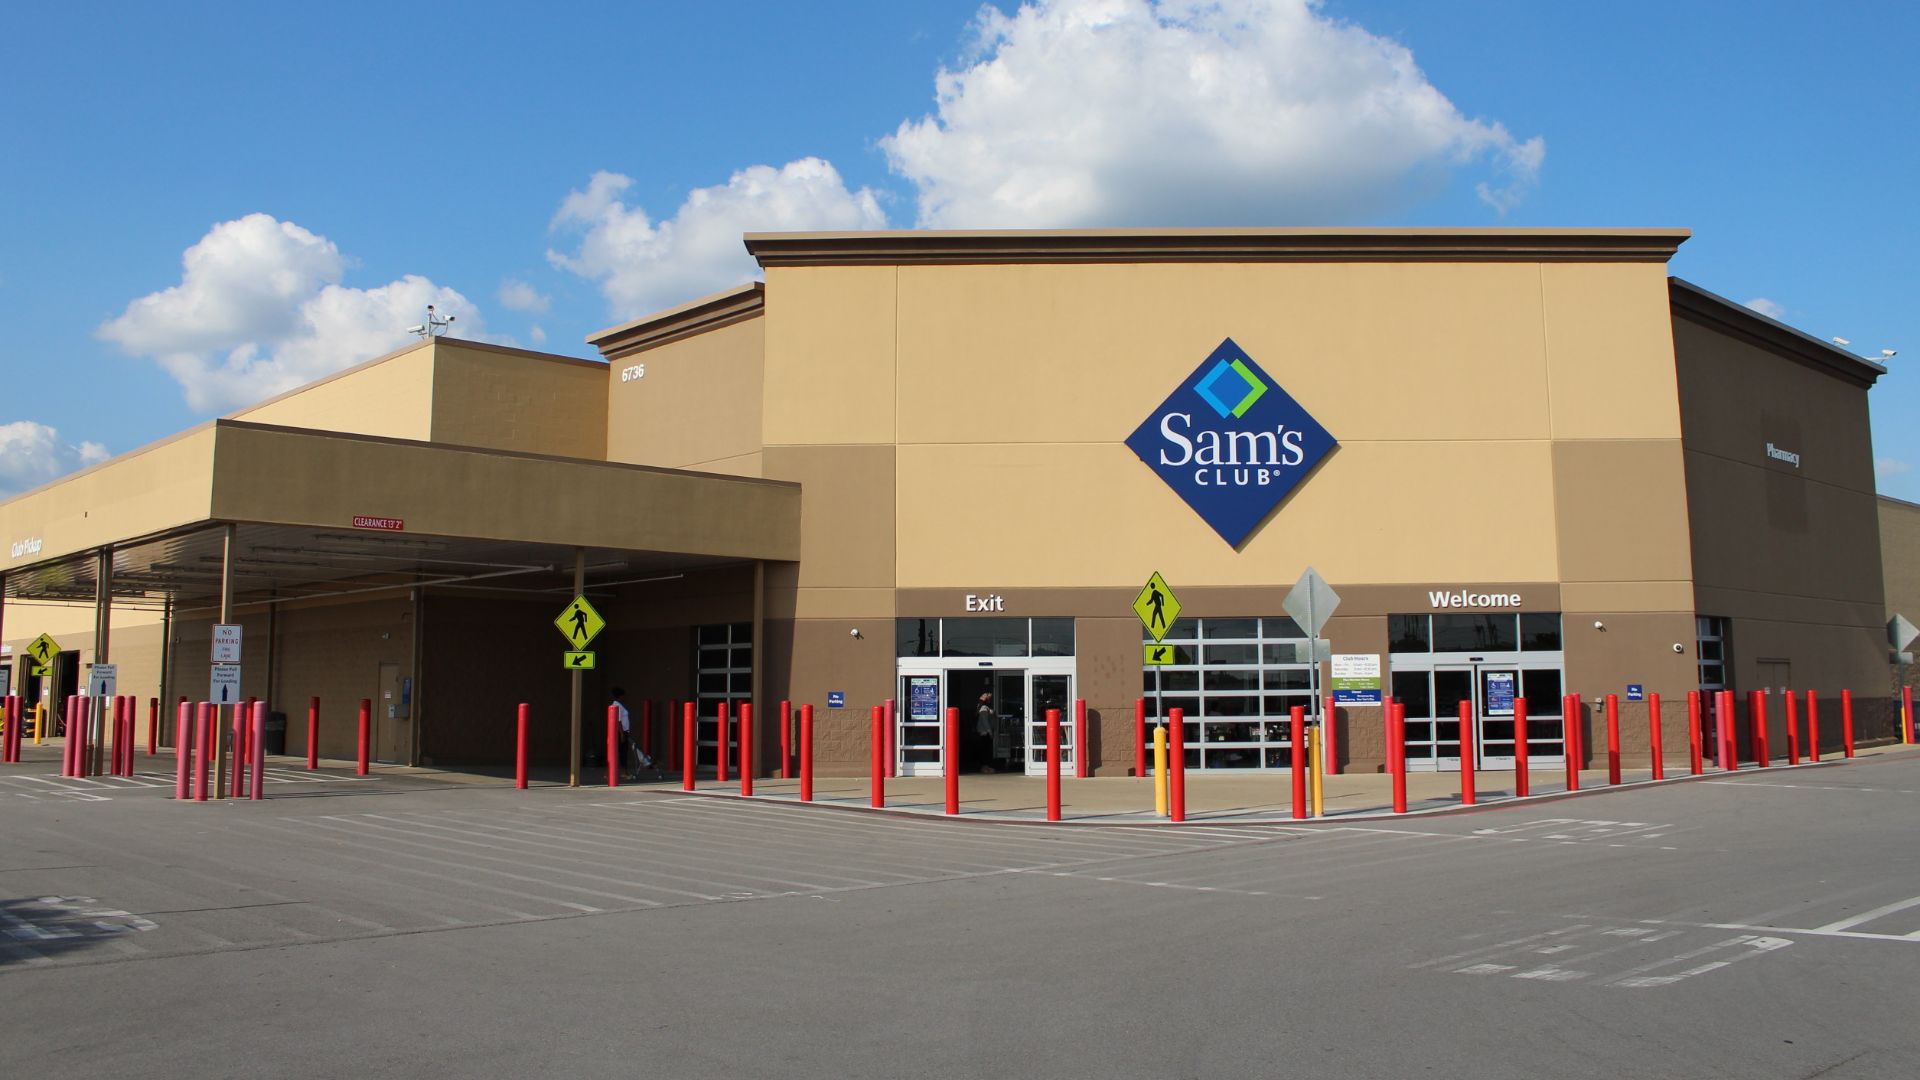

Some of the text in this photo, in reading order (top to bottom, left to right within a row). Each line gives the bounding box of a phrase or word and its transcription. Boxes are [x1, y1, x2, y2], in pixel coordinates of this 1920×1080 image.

[622, 364, 645, 382] 6736
[1160, 412, 1304, 467] Sam's
[1766, 442, 1800, 468] Pharmacy
[354, 517, 388, 528] CLEARANCE
[966, 594, 1004, 611] Exit
[1428, 589, 1522, 608] Welcome
